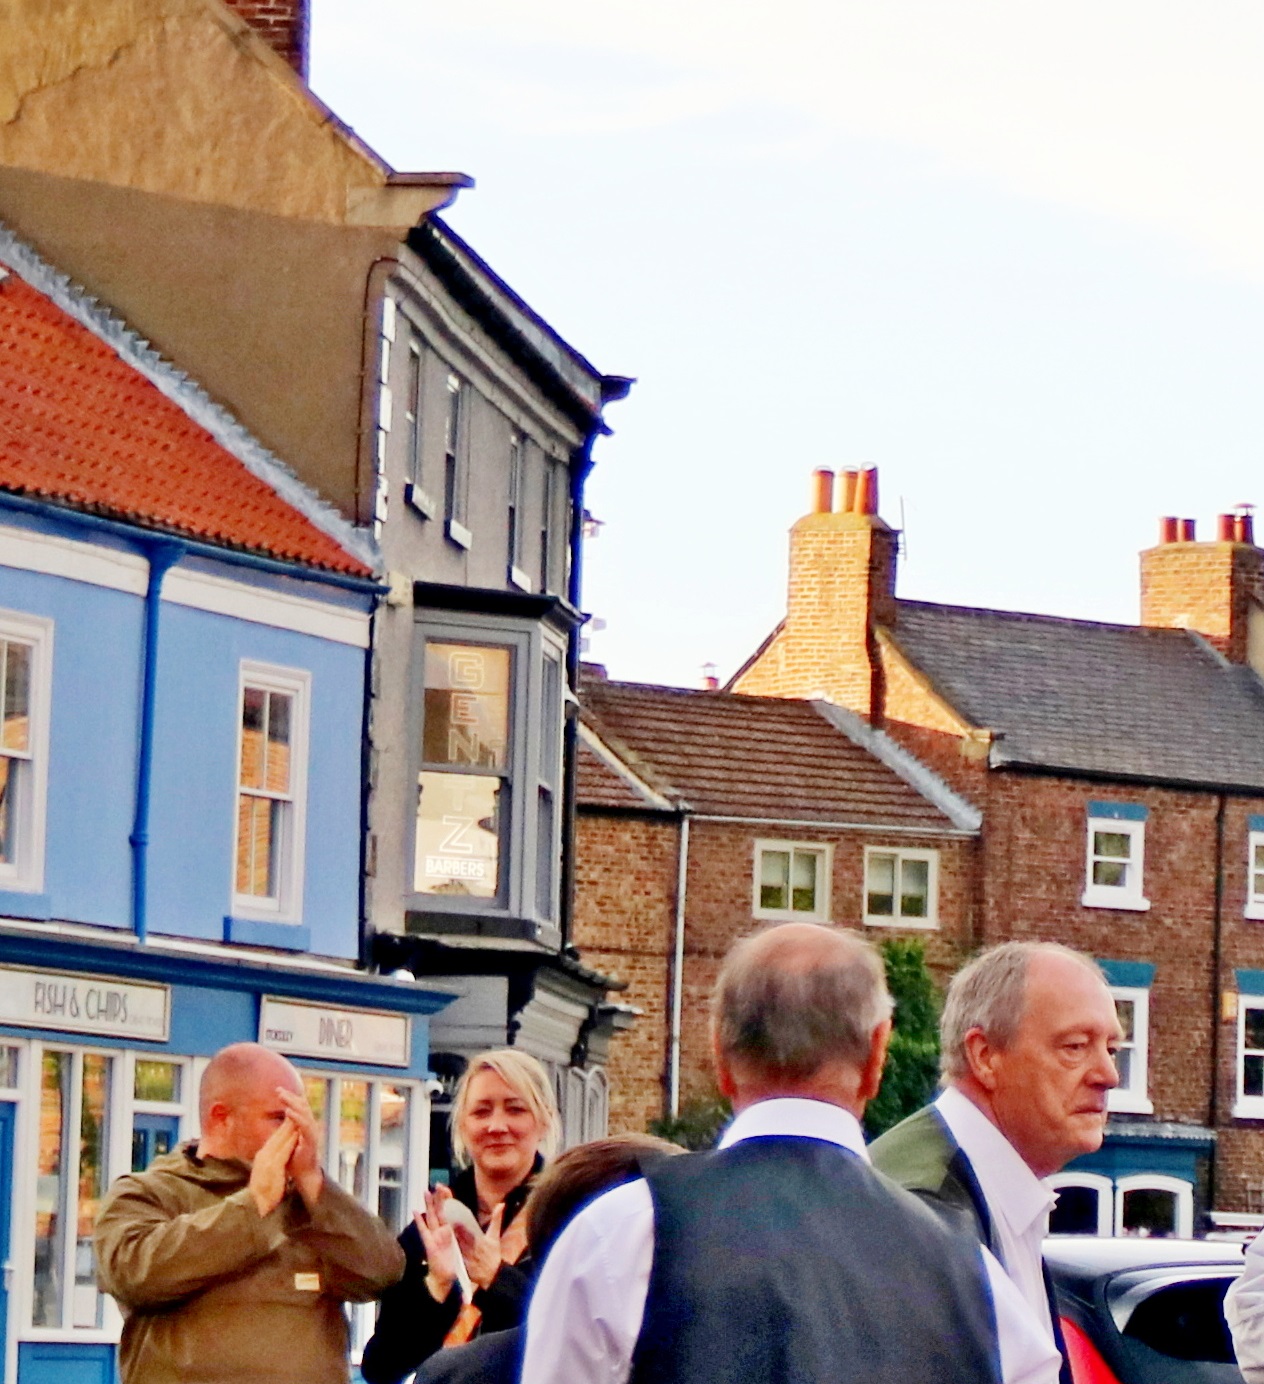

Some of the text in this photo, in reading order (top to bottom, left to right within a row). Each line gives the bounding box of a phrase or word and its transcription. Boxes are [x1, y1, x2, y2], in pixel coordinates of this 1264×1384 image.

[424, 857, 485, 877] BARBERS
[34, 981, 66, 1016] FISH
[69, 986, 79, 1018] &
[85, 988, 128, 1023] CHIPS
